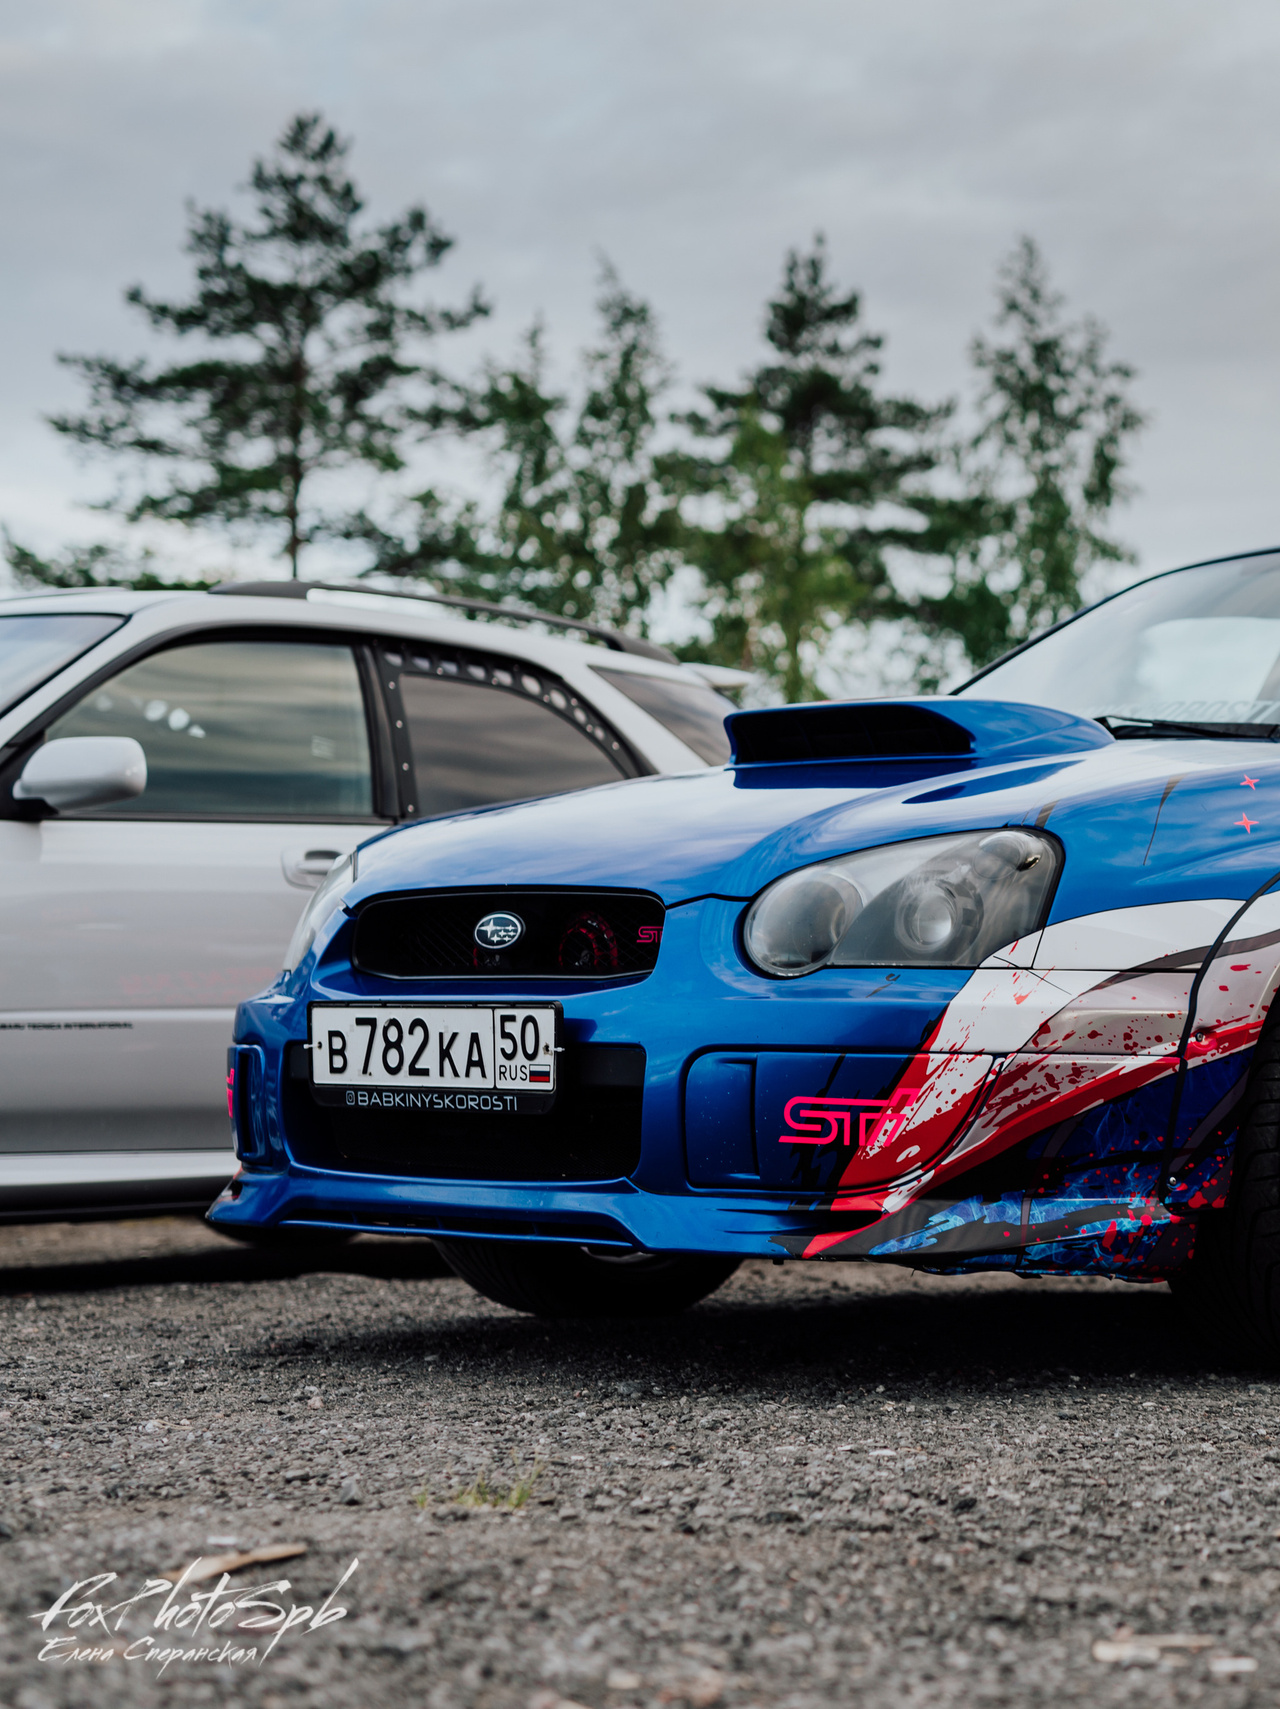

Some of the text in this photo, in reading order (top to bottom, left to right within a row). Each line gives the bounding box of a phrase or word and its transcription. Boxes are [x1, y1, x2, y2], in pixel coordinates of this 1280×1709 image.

[500, 1014, 540, 1061] 50
[499, 1064, 528, 1081] RUS
[778, 1087, 922, 1147] STI
